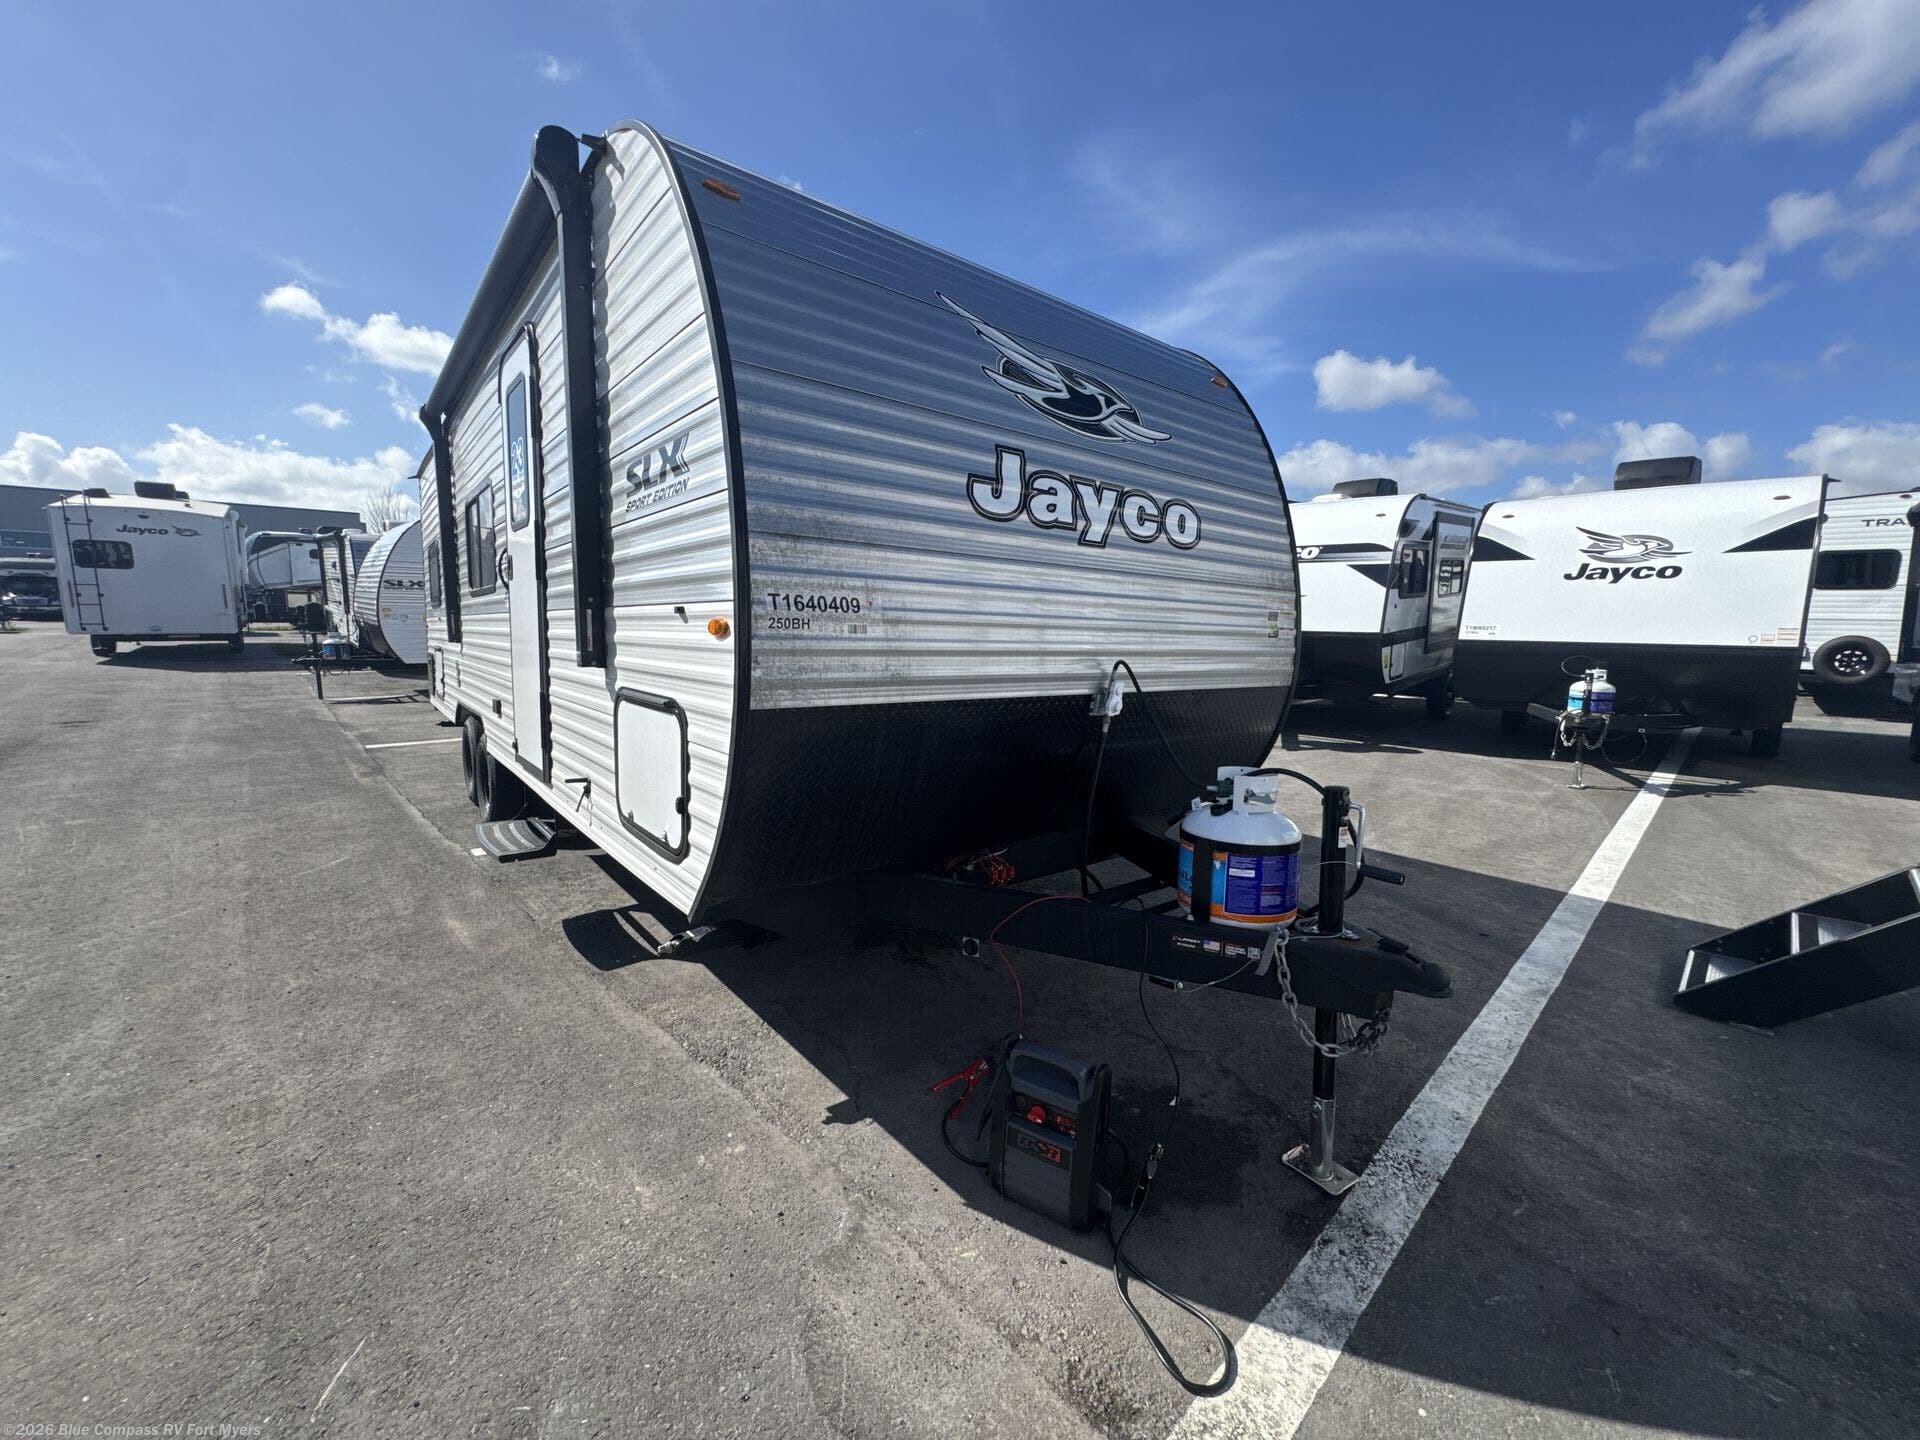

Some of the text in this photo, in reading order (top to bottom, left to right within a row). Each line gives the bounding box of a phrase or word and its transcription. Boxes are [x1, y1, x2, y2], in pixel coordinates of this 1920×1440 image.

[626, 432, 690, 499] SLX
[625, 476, 690, 513] SPORT EDITION
[966, 443, 1202, 551] Jayco
[115, 524, 169, 536] Jayco
[1563, 563, 1683, 584] Jayco
[767, 592, 861, 613] T1640409
[768, 617, 810, 630] 250BH
